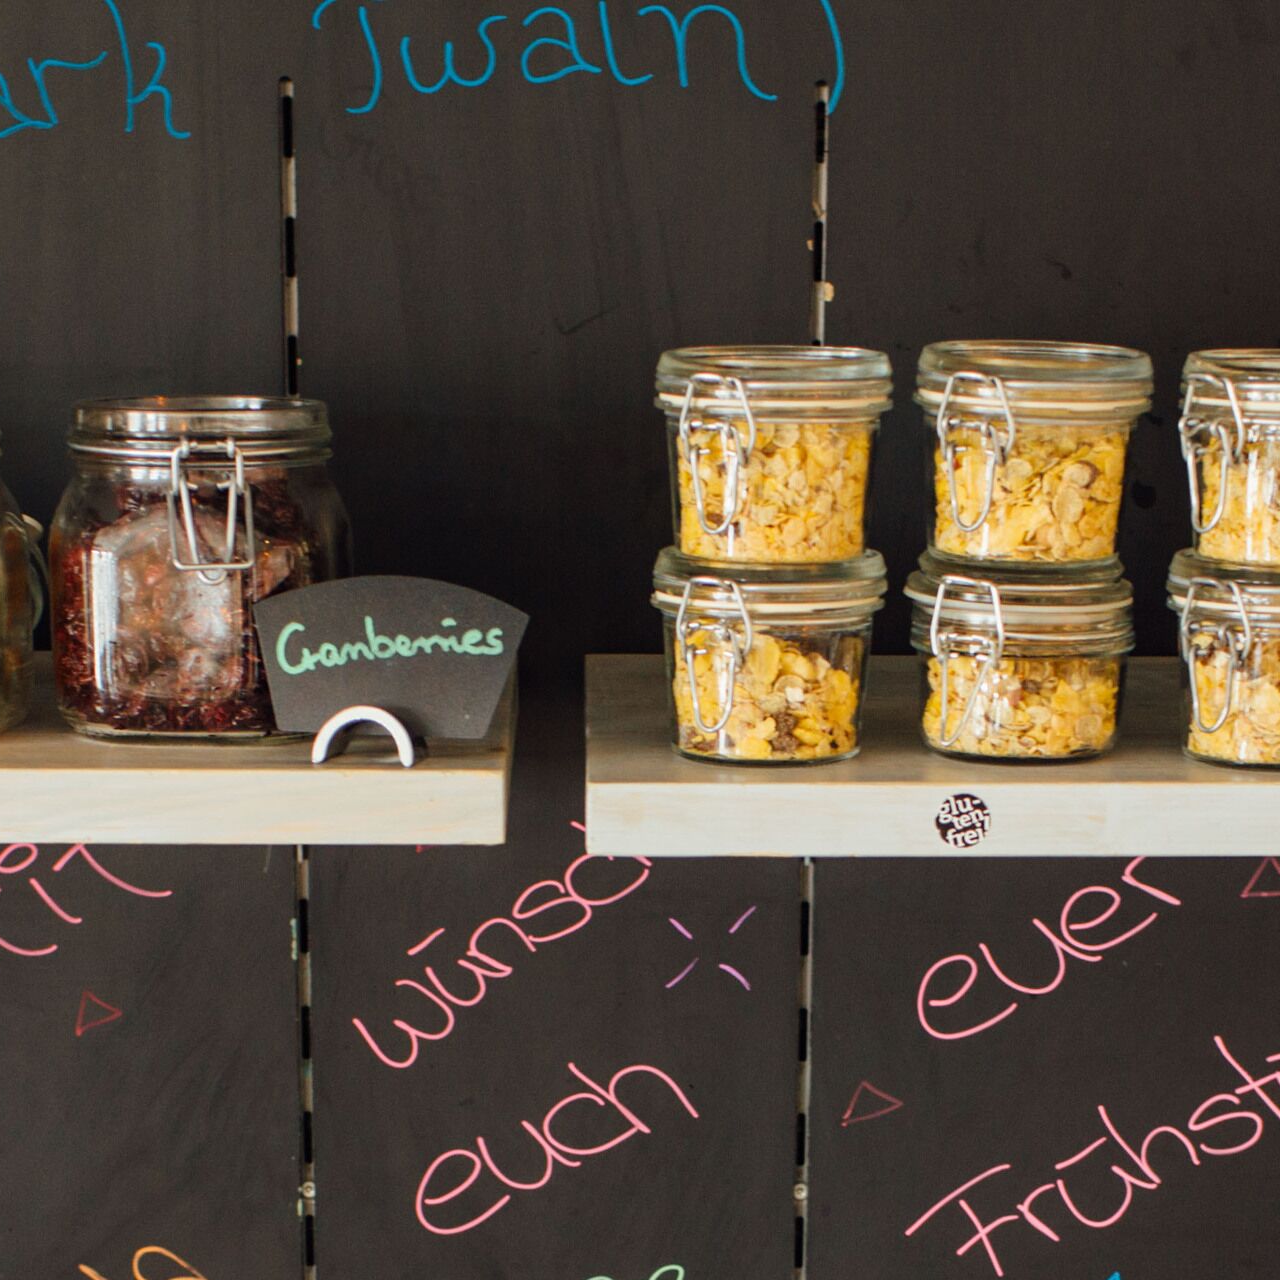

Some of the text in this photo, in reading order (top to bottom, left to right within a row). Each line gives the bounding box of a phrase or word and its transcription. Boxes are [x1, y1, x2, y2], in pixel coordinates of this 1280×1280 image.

[276, 616, 504, 676] Cranberries
[938, 796, 982, 824] glu-
[917, 856, 1181, 1041] euer
[415, 1062, 699, 1235] euch
